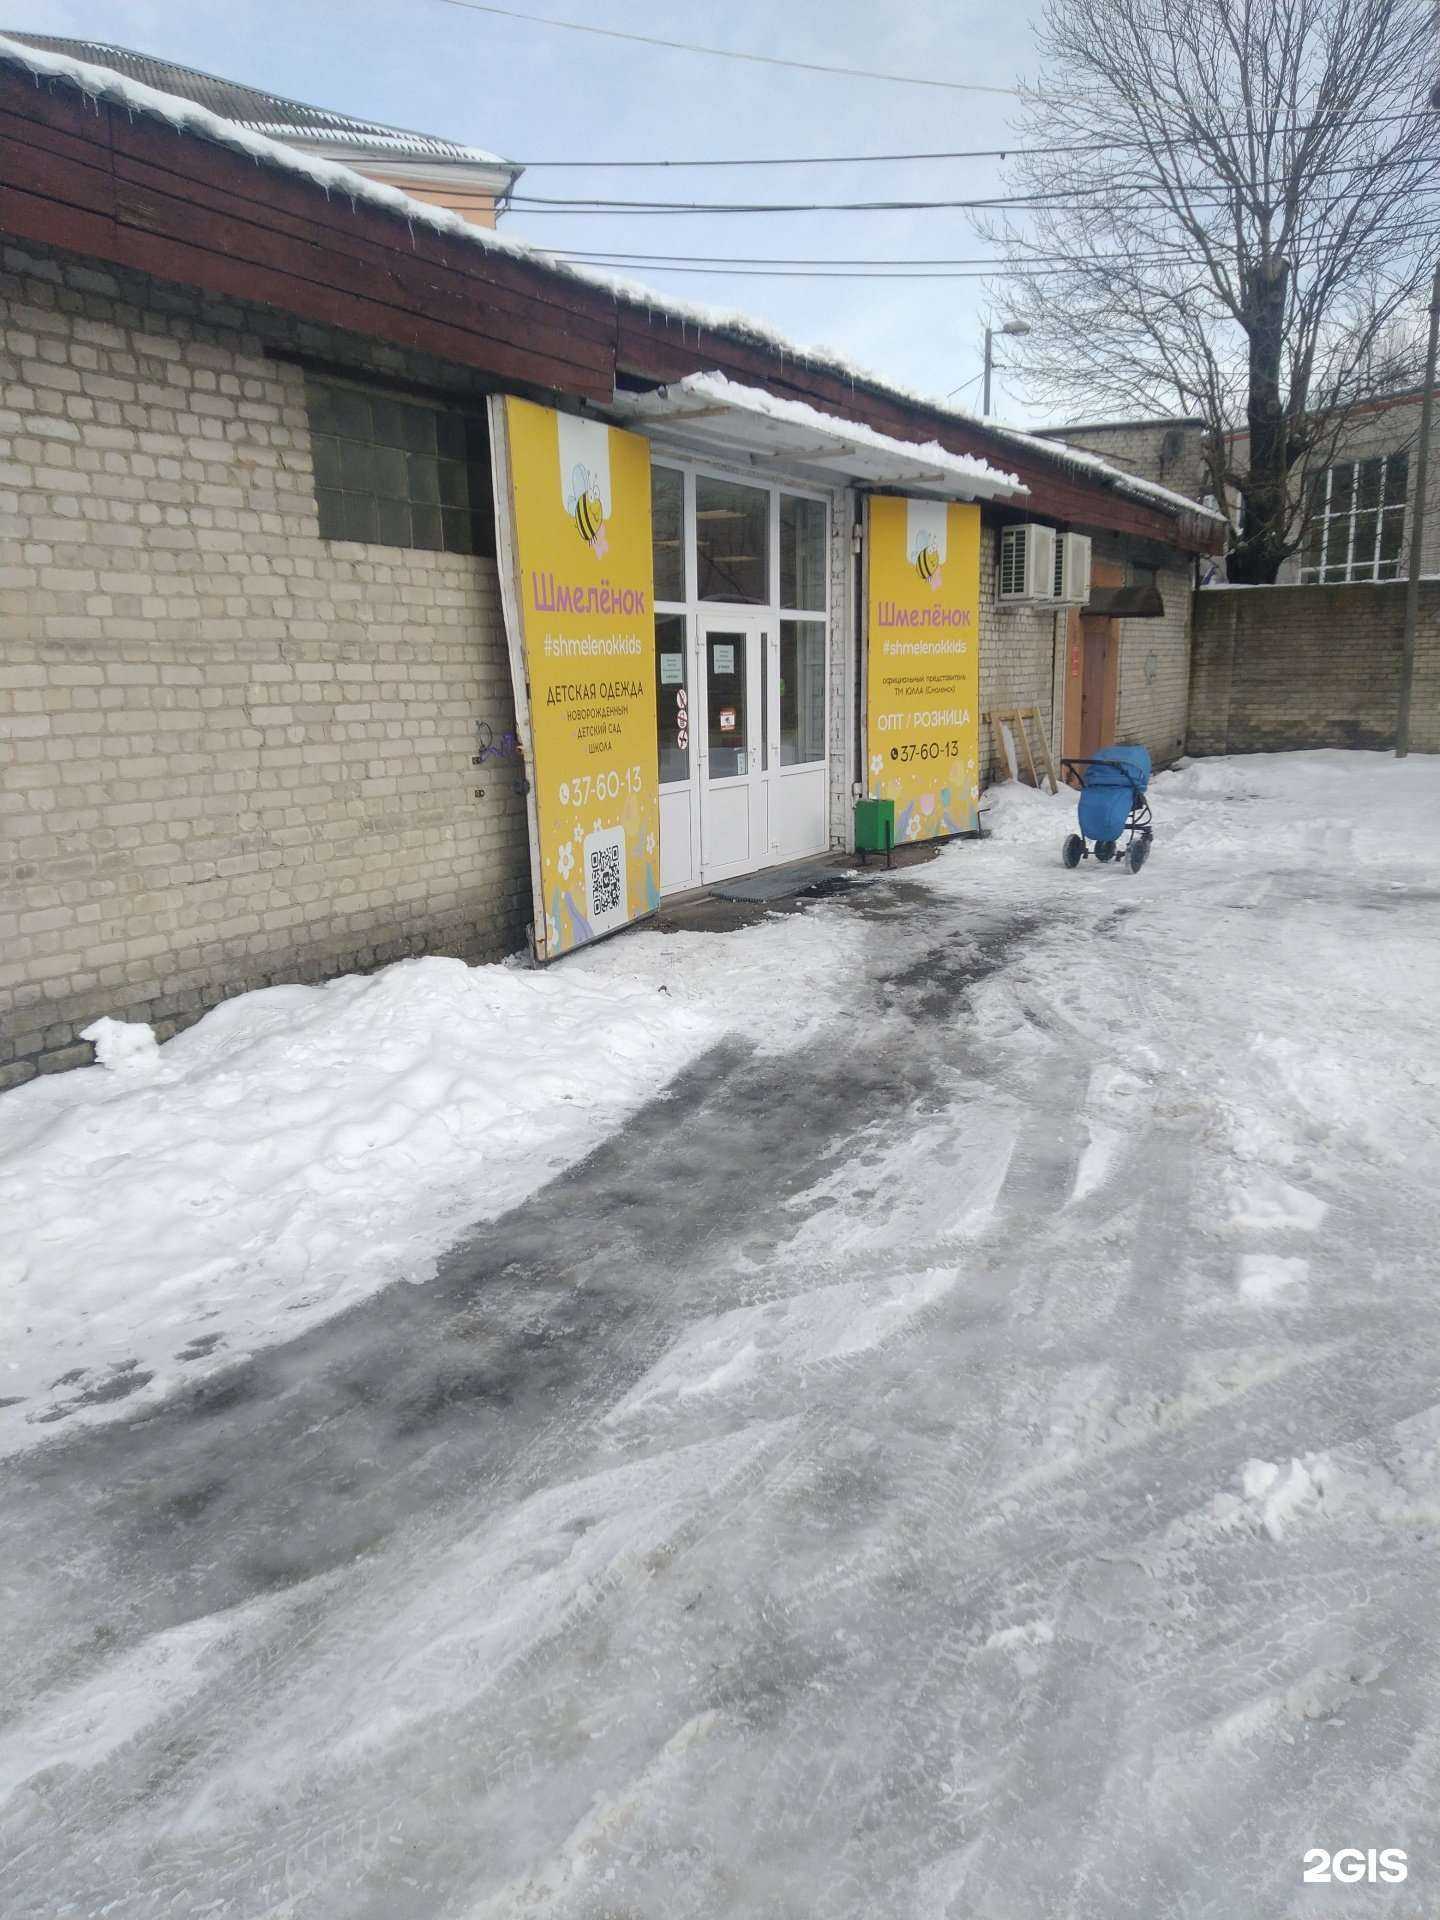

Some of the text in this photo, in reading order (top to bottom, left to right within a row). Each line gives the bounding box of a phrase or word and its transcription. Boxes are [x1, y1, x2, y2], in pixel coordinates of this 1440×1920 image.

[532, 571, 645, 615] Шмелёнок
[878, 601, 971, 628] Шмелёнок
[544, 633, 642, 657] #shmelenokkids
[883, 640, 968, 656] #shmelenokkids
[546, 681, 644, 706] ДЕТСКАЯ ОДЕЖДА
[567, 704, 629, 721] НОВОРОЖДЕННЫМ
[878, 713, 904, 731] ОПТ
[914, 709, 970, 729] РОЗНИЦА
[577, 722, 622, 741] ДЕТСКИЙ САД
[588, 741, 612, 754] ШКОЛА
[901, 740, 959, 762] 37-60-13
[571, 766, 642, 806] 37-60-13
